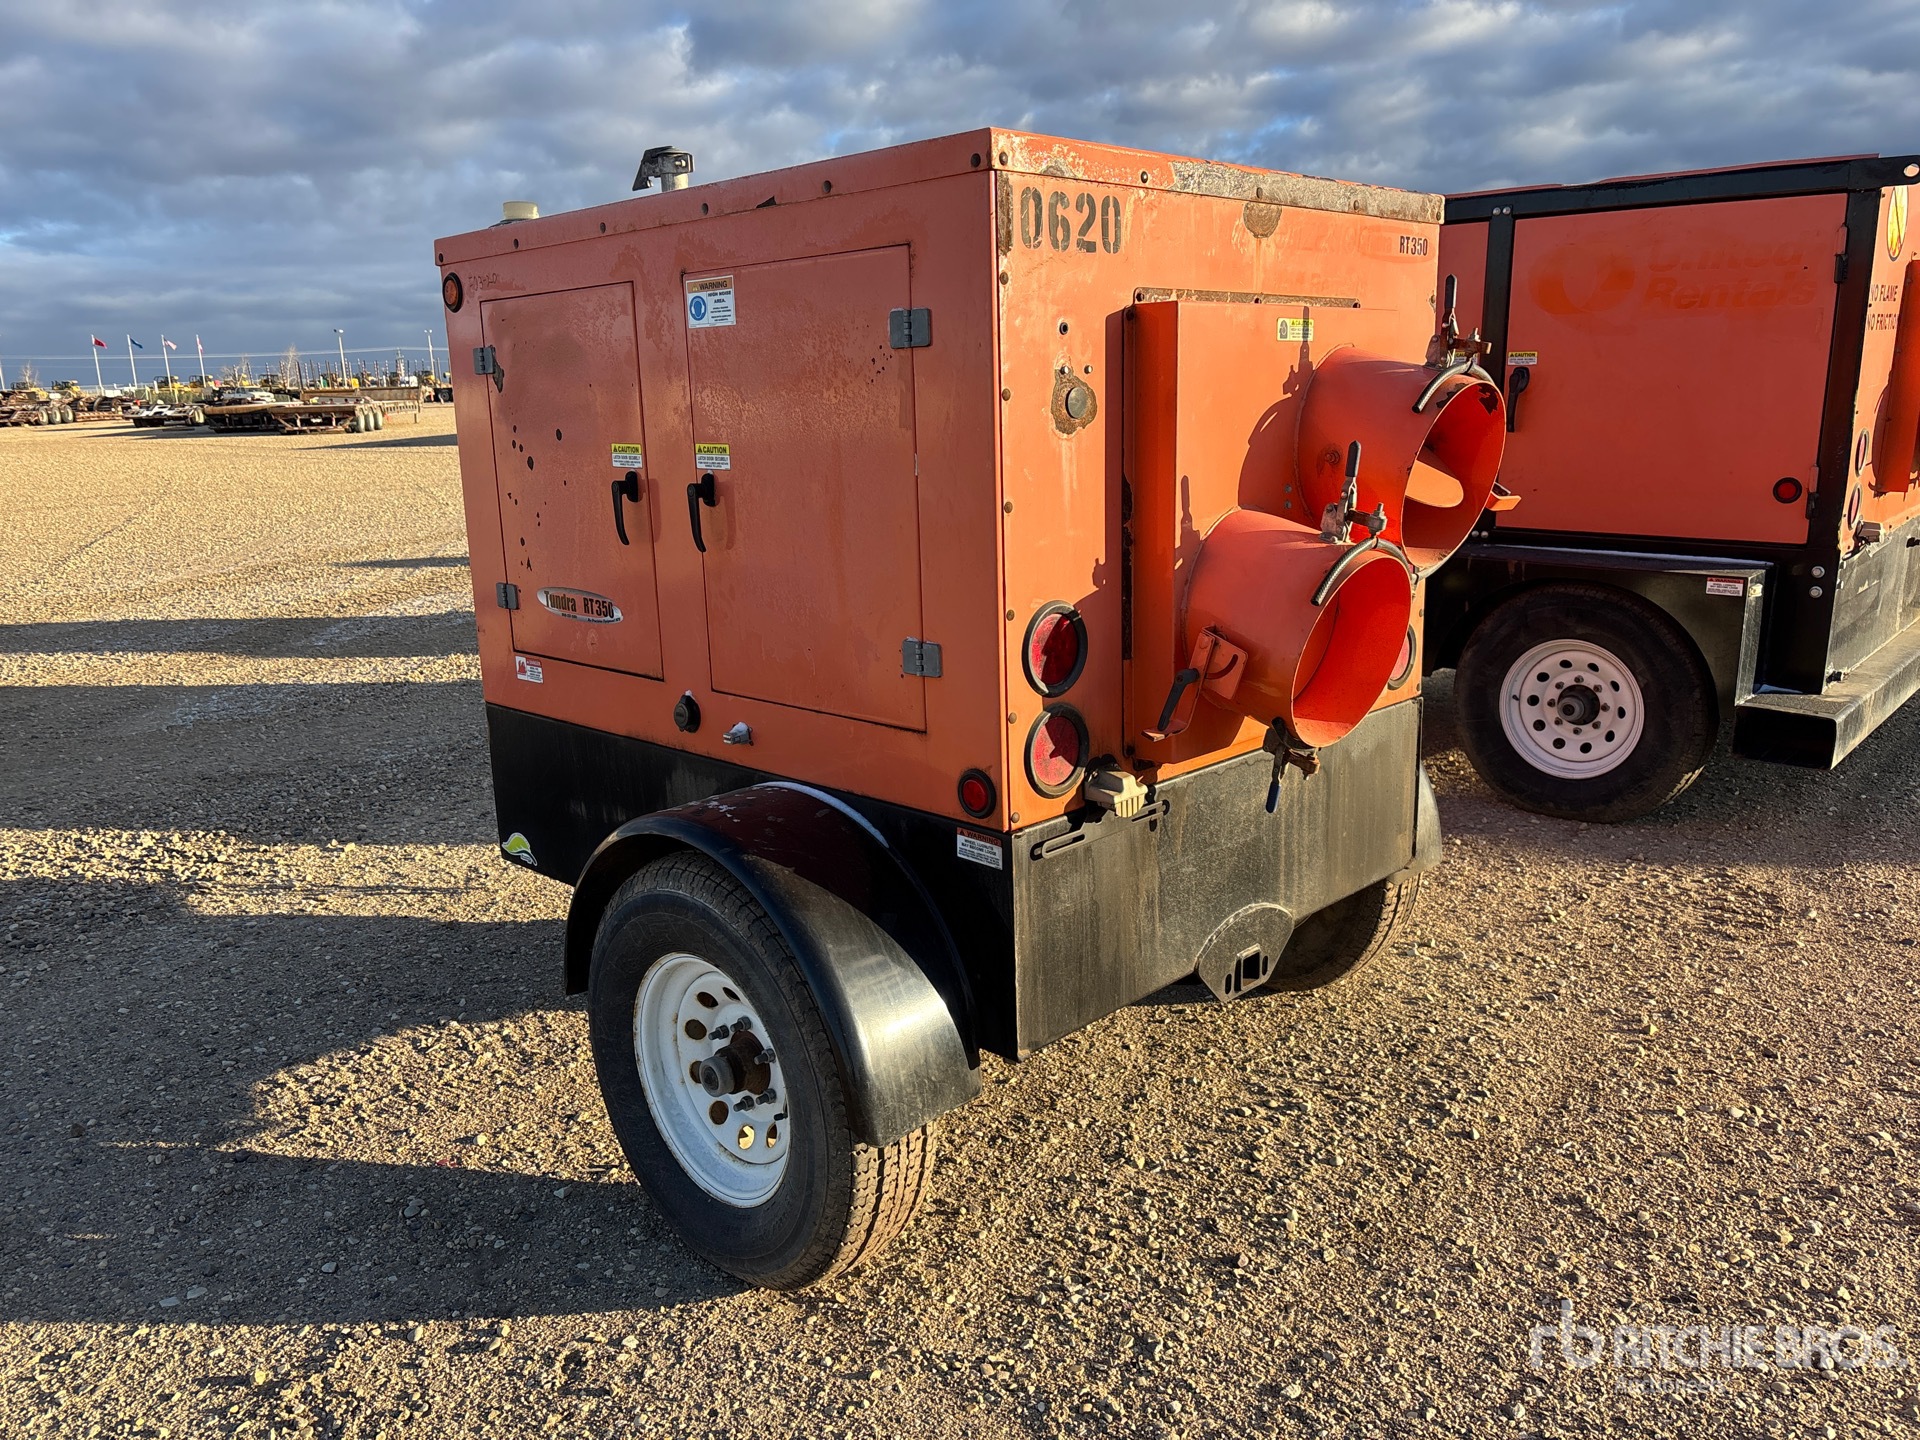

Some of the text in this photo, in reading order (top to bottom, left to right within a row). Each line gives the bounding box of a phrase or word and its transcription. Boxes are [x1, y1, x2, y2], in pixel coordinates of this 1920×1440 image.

[1020, 186, 1122, 255] 0620
[1399, 235, 1429, 256] RT350
[699, 281, 728, 290] WARNING
[1871, 284, 1898, 301] NO FLAME
[1867, 313, 1899, 330] NO FRICTIO
[702, 446, 727, 454] CAUTION
[544, 590, 615, 618] Tundra RT350
[969, 831, 1000, 846] WARNING
